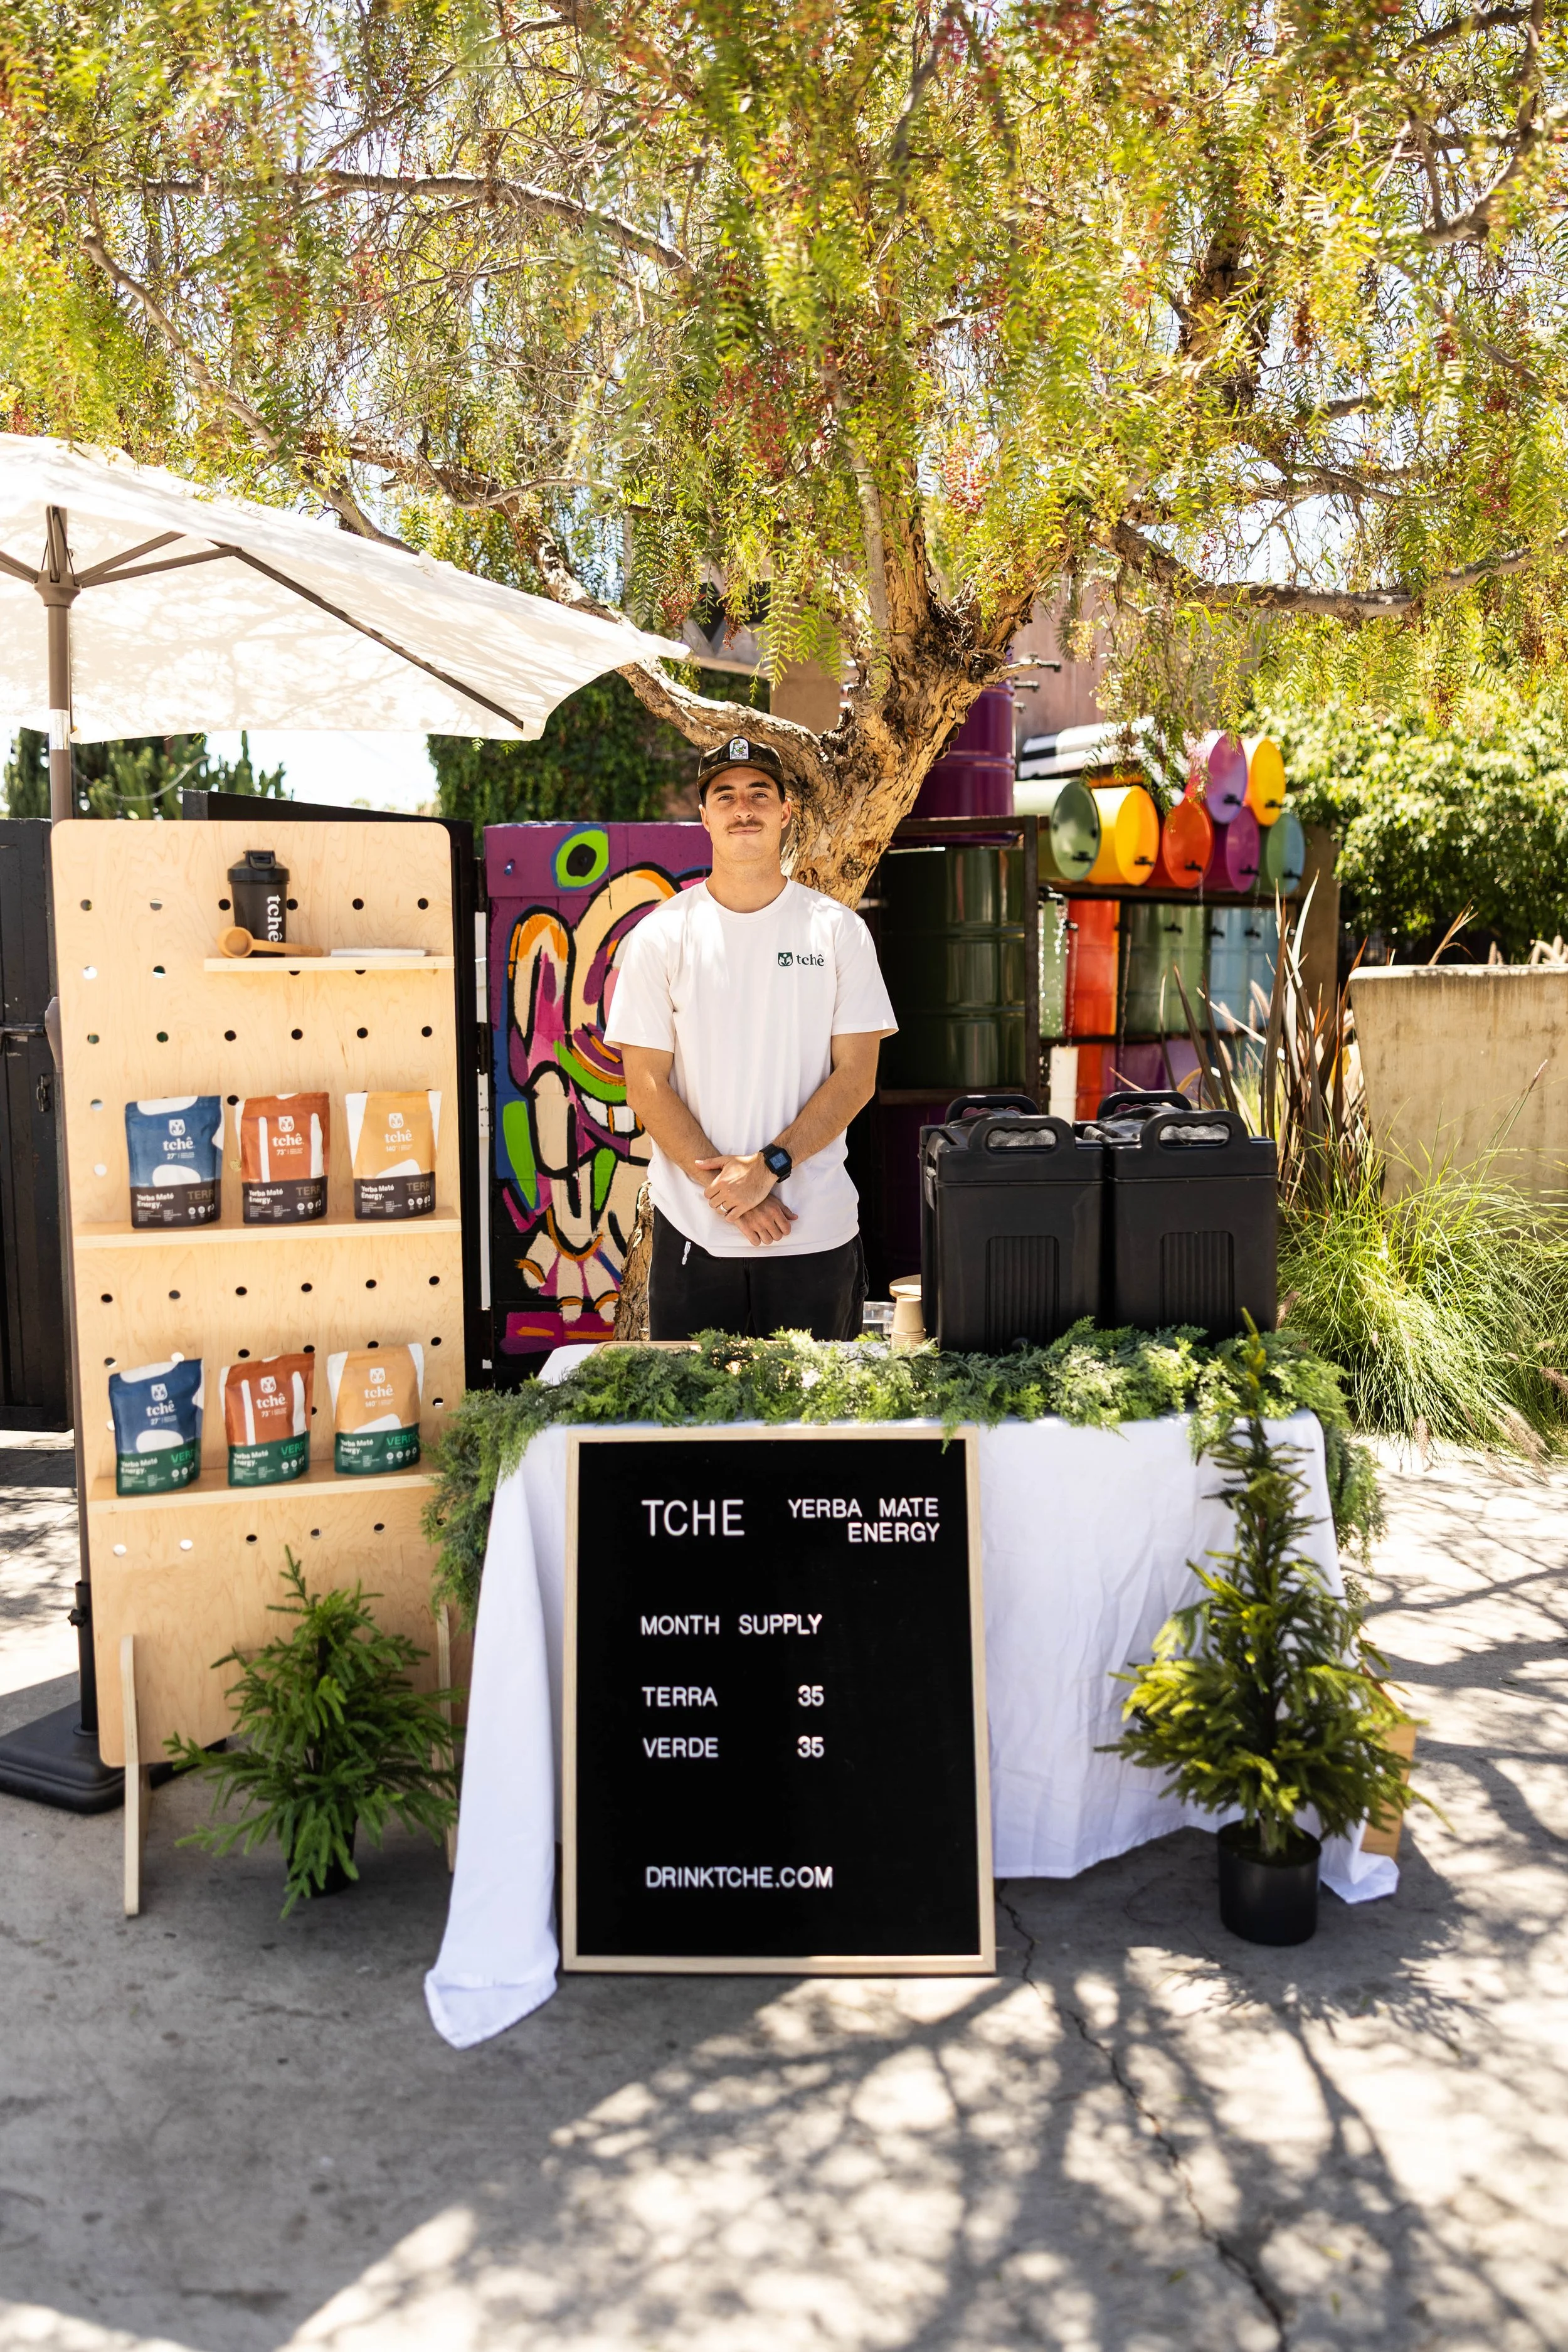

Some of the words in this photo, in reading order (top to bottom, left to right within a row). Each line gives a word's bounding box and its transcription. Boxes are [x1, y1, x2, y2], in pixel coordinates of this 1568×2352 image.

[267, 895, 282, 942] tchê
[796, 953, 825, 967] tchê
[163, 1136, 194, 1151] tchê
[272, 1133, 303, 1147] tchê
[384, 1130, 412, 1143] tchê
[188, 1189, 213, 1200] TERR
[296, 1185, 320, 1196] TERR
[406, 1181, 430, 1192] TERR
[364, 1384, 393, 1398] tchê
[146, 1400, 175, 1417] tchê
[256, 1393, 286, 1409] tchê
[788, 1498, 863, 1518] YERBA
[879, 1497, 939, 1518] MATE
[642, 1499, 745, 1536] TCHE
[847, 1522, 940, 1543] ENERGY
[641, 1614, 719, 1635] MONTH
[739, 1613, 823, 1635] SUPPLY
[642, 1687, 718, 1707] TERRA
[798, 1685, 824, 1707] 35
[643, 1737, 719, 1758] VERDE
[797, 1735, 824, 1758] 35
[646, 1866, 833, 1888] DRINKTCHE.COM
